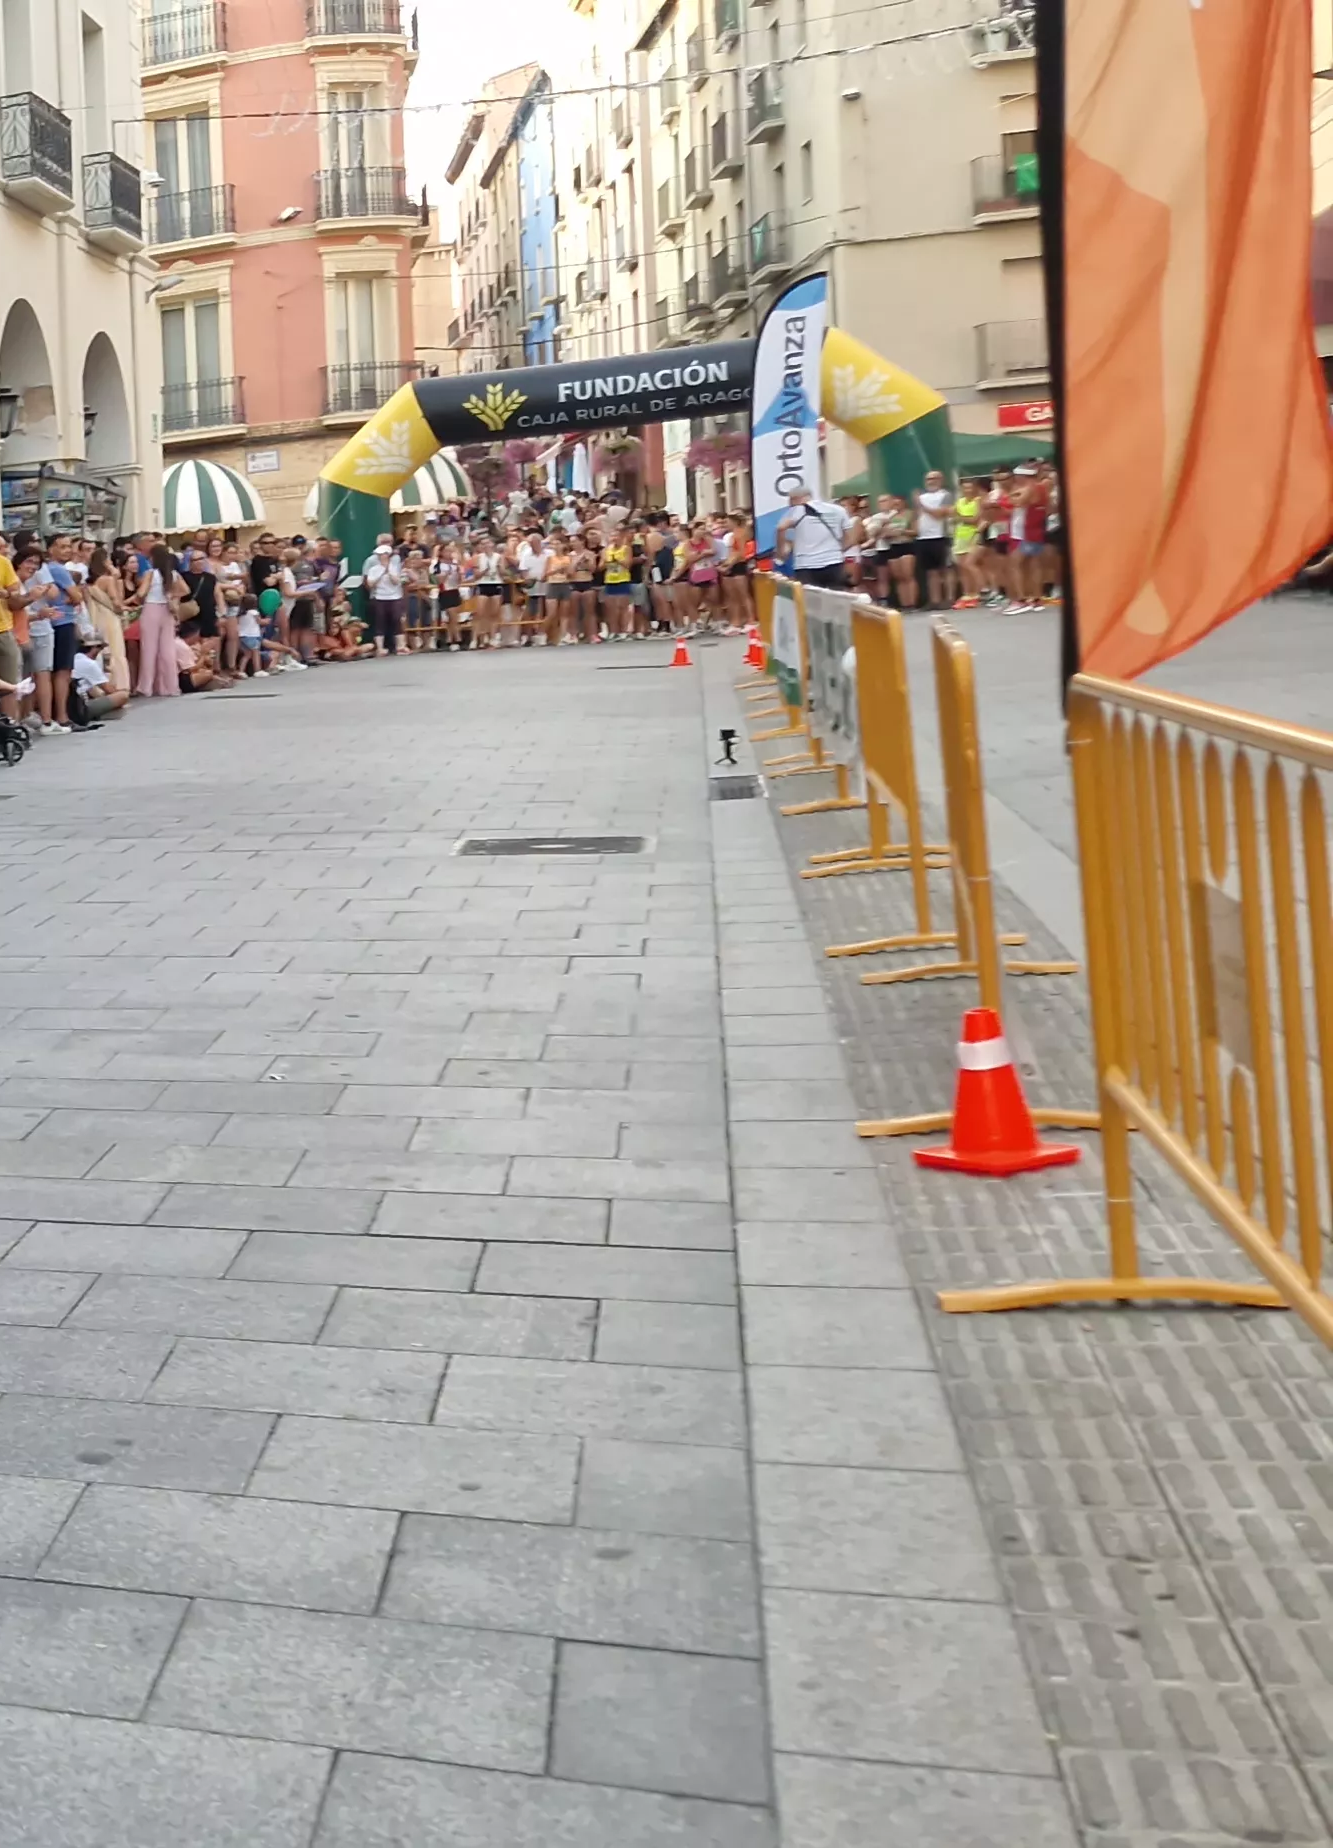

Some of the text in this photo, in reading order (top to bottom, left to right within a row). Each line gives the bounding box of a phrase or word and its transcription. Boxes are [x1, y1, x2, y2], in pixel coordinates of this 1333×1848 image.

[558, 359, 729, 403] FUNDACIÓN
[517, 411, 569, 428] CAJA
[575, 402, 643, 421] RURAL
[650, 397, 677, 412] DE
[774, 315, 806, 497] OrtoAvanza
